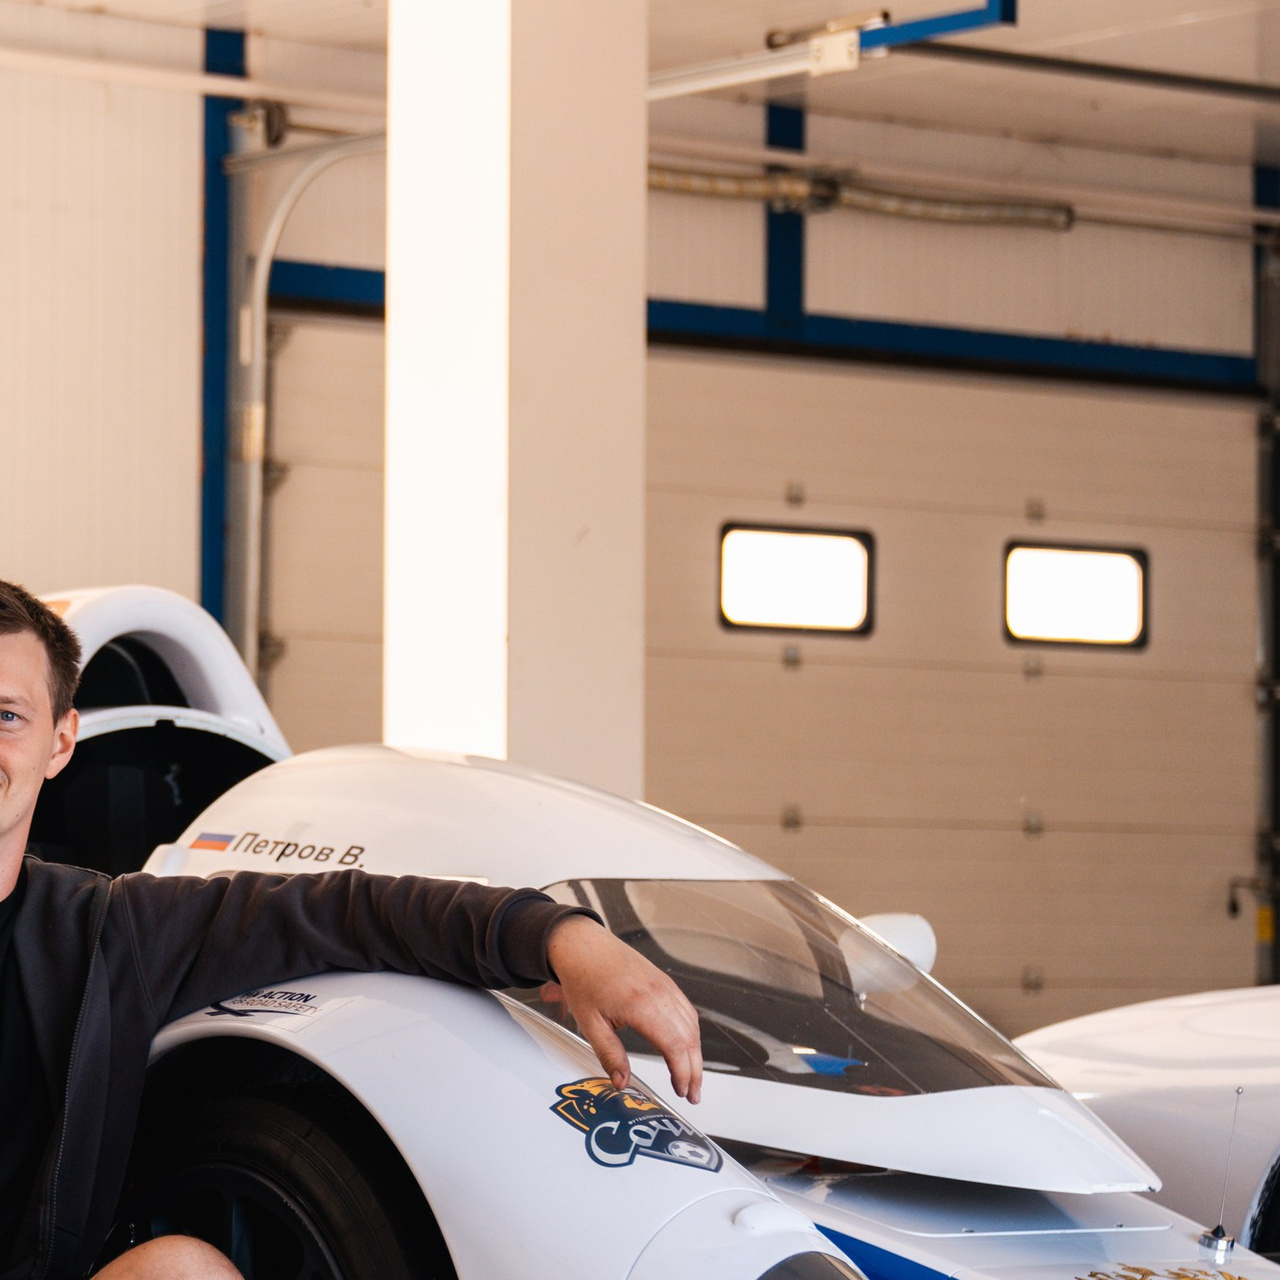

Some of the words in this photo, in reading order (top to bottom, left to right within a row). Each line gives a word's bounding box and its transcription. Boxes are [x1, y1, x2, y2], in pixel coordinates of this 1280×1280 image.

[232, 832, 335, 862] Петров
[261, 991, 317, 1003] ACTION
[274, 1000, 324, 1014] SAFETY
